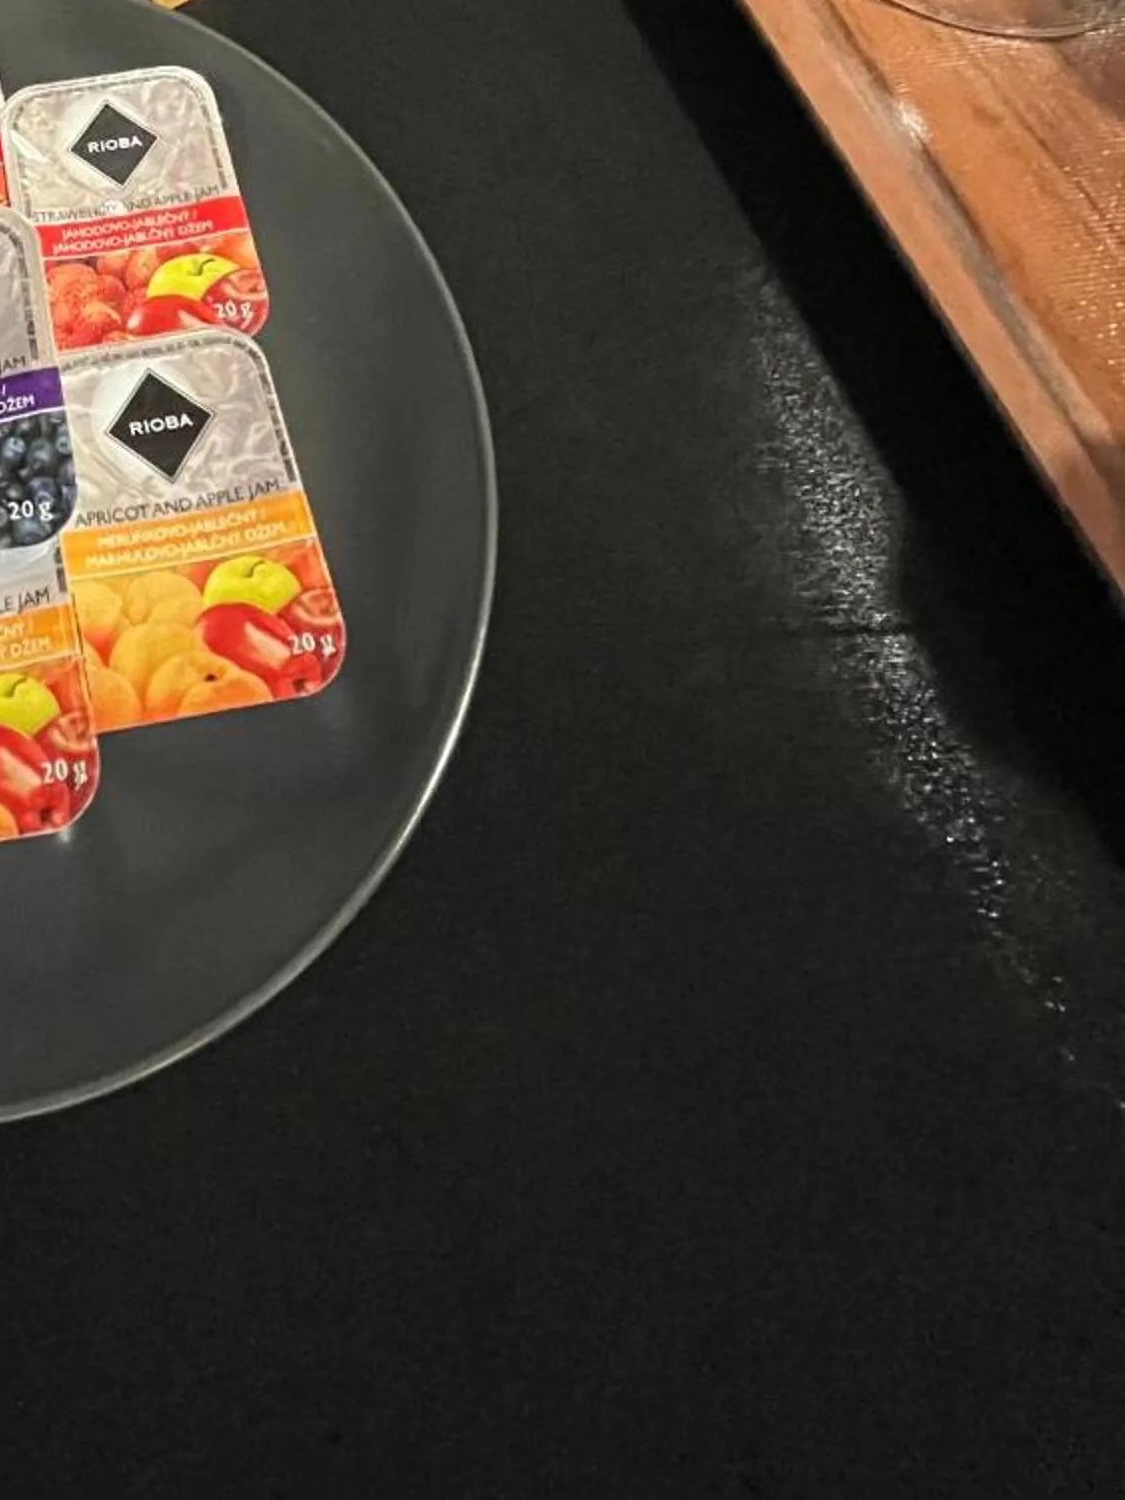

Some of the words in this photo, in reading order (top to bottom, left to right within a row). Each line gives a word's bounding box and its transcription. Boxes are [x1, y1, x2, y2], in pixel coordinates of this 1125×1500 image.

[86, 134, 143, 154] RIOBA
[128, 413, 194, 436] RIOBA
[8, 499, 35, 520] 20
[39, 498, 55, 522] g
[75, 503, 149, 528] APRICOT
[151, 496, 192, 519] AND
[195, 485, 246, 511] APPLE
[248, 478, 281, 503] JAM
[16, 586, 51, 615] JAM
[288, 632, 316, 656] 20
[41, 759, 68, 784] 20
